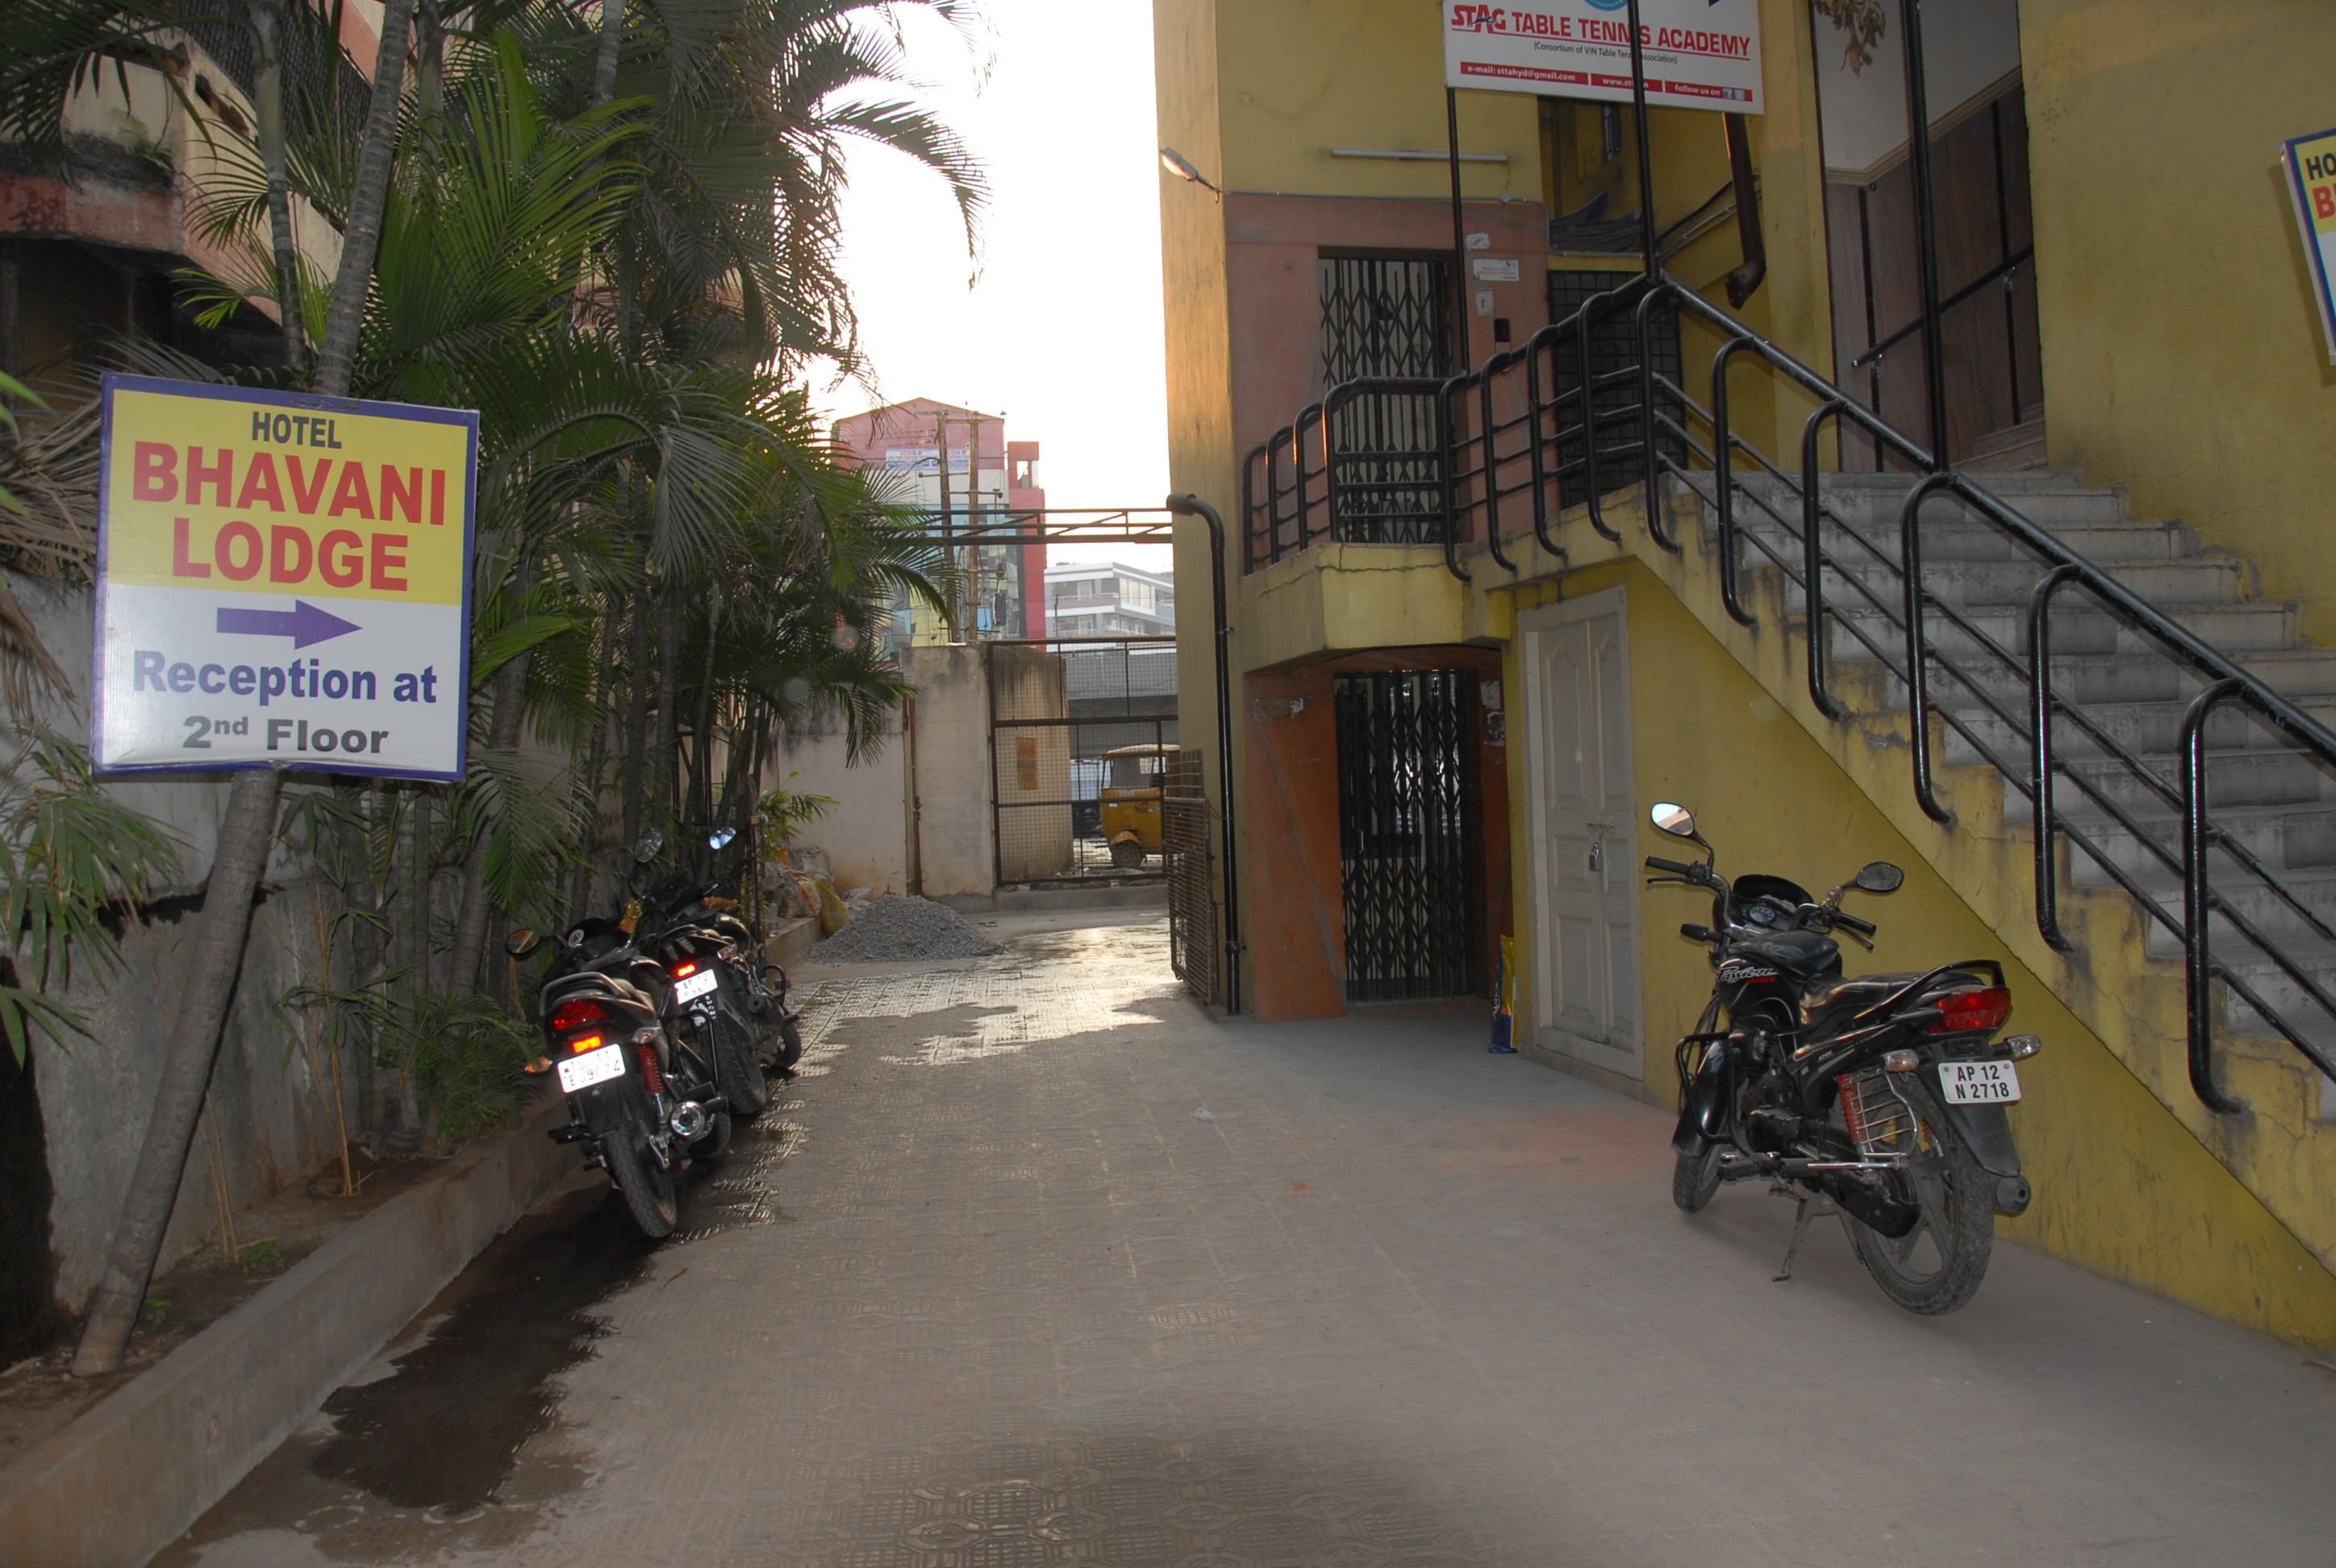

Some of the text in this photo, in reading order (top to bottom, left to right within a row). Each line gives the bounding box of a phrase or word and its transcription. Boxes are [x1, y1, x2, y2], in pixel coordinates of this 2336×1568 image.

[1451, 4, 1751, 57] STAG TABLE TENNS ACADEMY
[1467, 65, 1496, 75] e-mail:
[1533, 41, 1575, 53] (Consortium
[1575, 45, 1583, 54] of
[1584, 46, 1597, 56] VIN
[1598, 48, 1616, 58] Table
[1642, 53, 1678, 65] ssociation)
[1675, 83, 1699, 95] follow
[1700, 88, 1709, 96] us
[251, 411, 343, 449] HOTEL
[132, 440, 446, 526] BHAVANI
[172, 517, 409, 592] LODGE
[133, 649, 438, 707] Reception at
[182, 715, 390, 754] 2nd Floor
[1954, 1082, 2009, 1099] N 2718
[1957, 1065, 2000, 1082] AP 12
